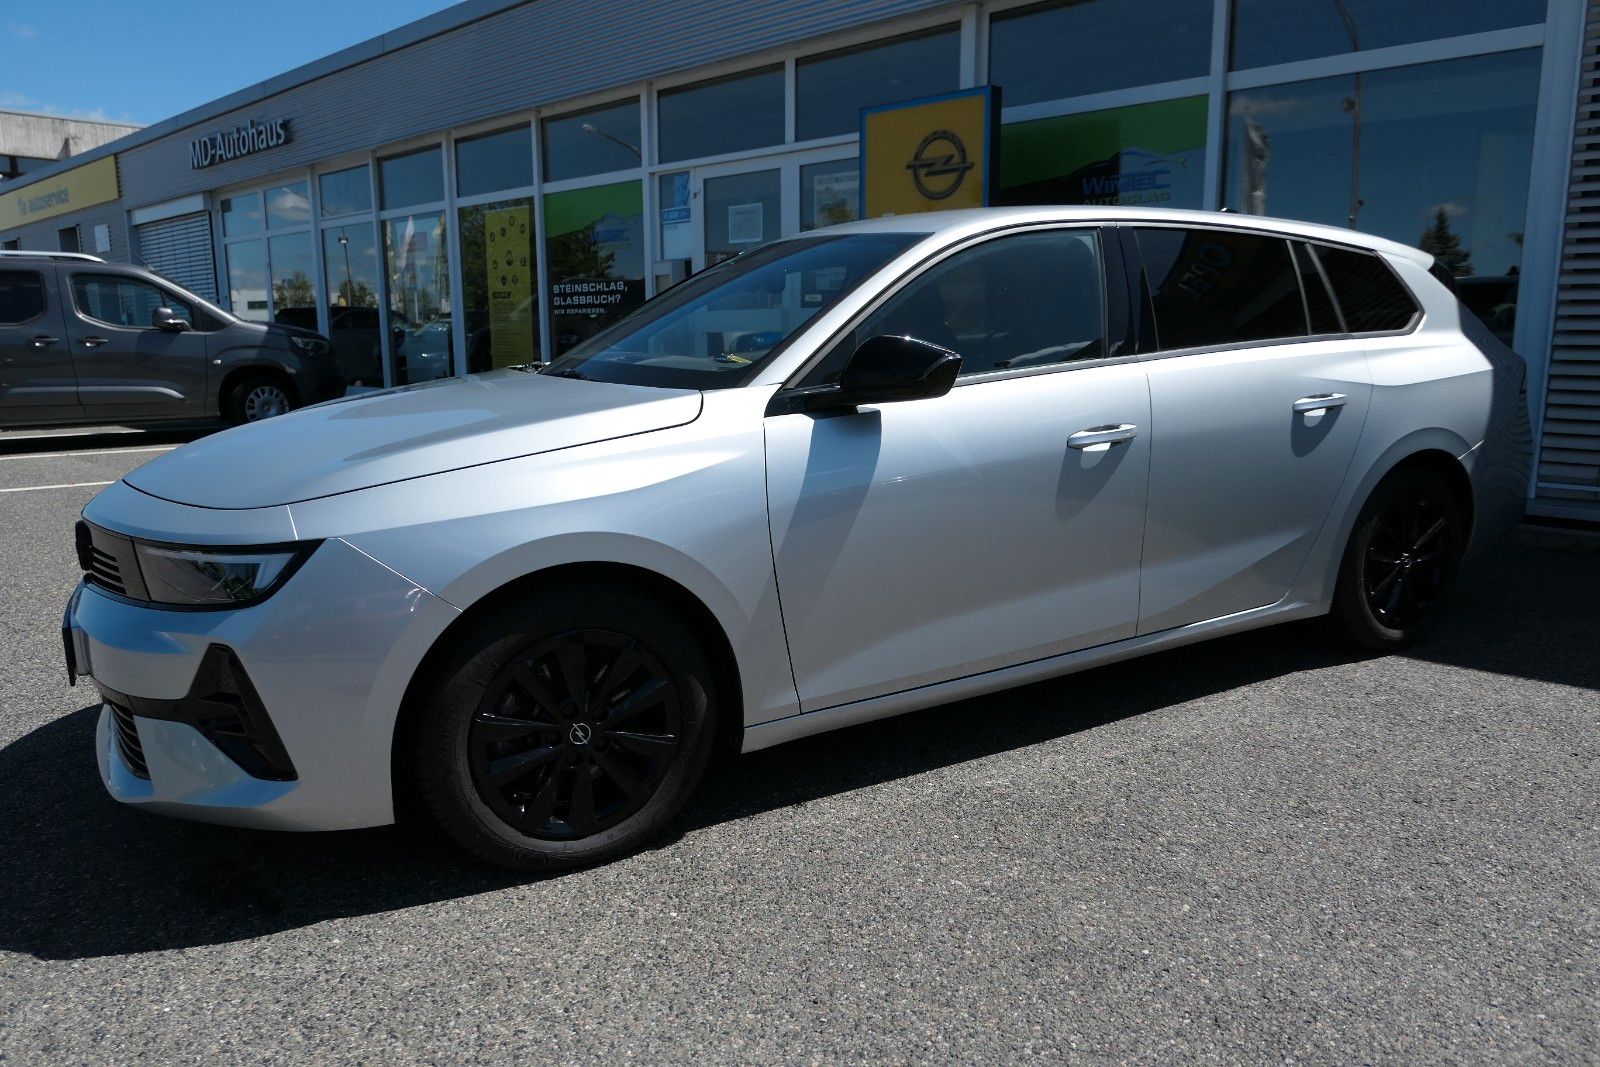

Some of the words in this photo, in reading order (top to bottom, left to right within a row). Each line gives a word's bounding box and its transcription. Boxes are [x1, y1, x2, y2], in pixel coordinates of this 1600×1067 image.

[190, 119, 285, 169] MD-Autohaus
[553, 281, 628, 294] STEINSCHLAG,
[553, 294, 621, 306] GLASBRUCH?
